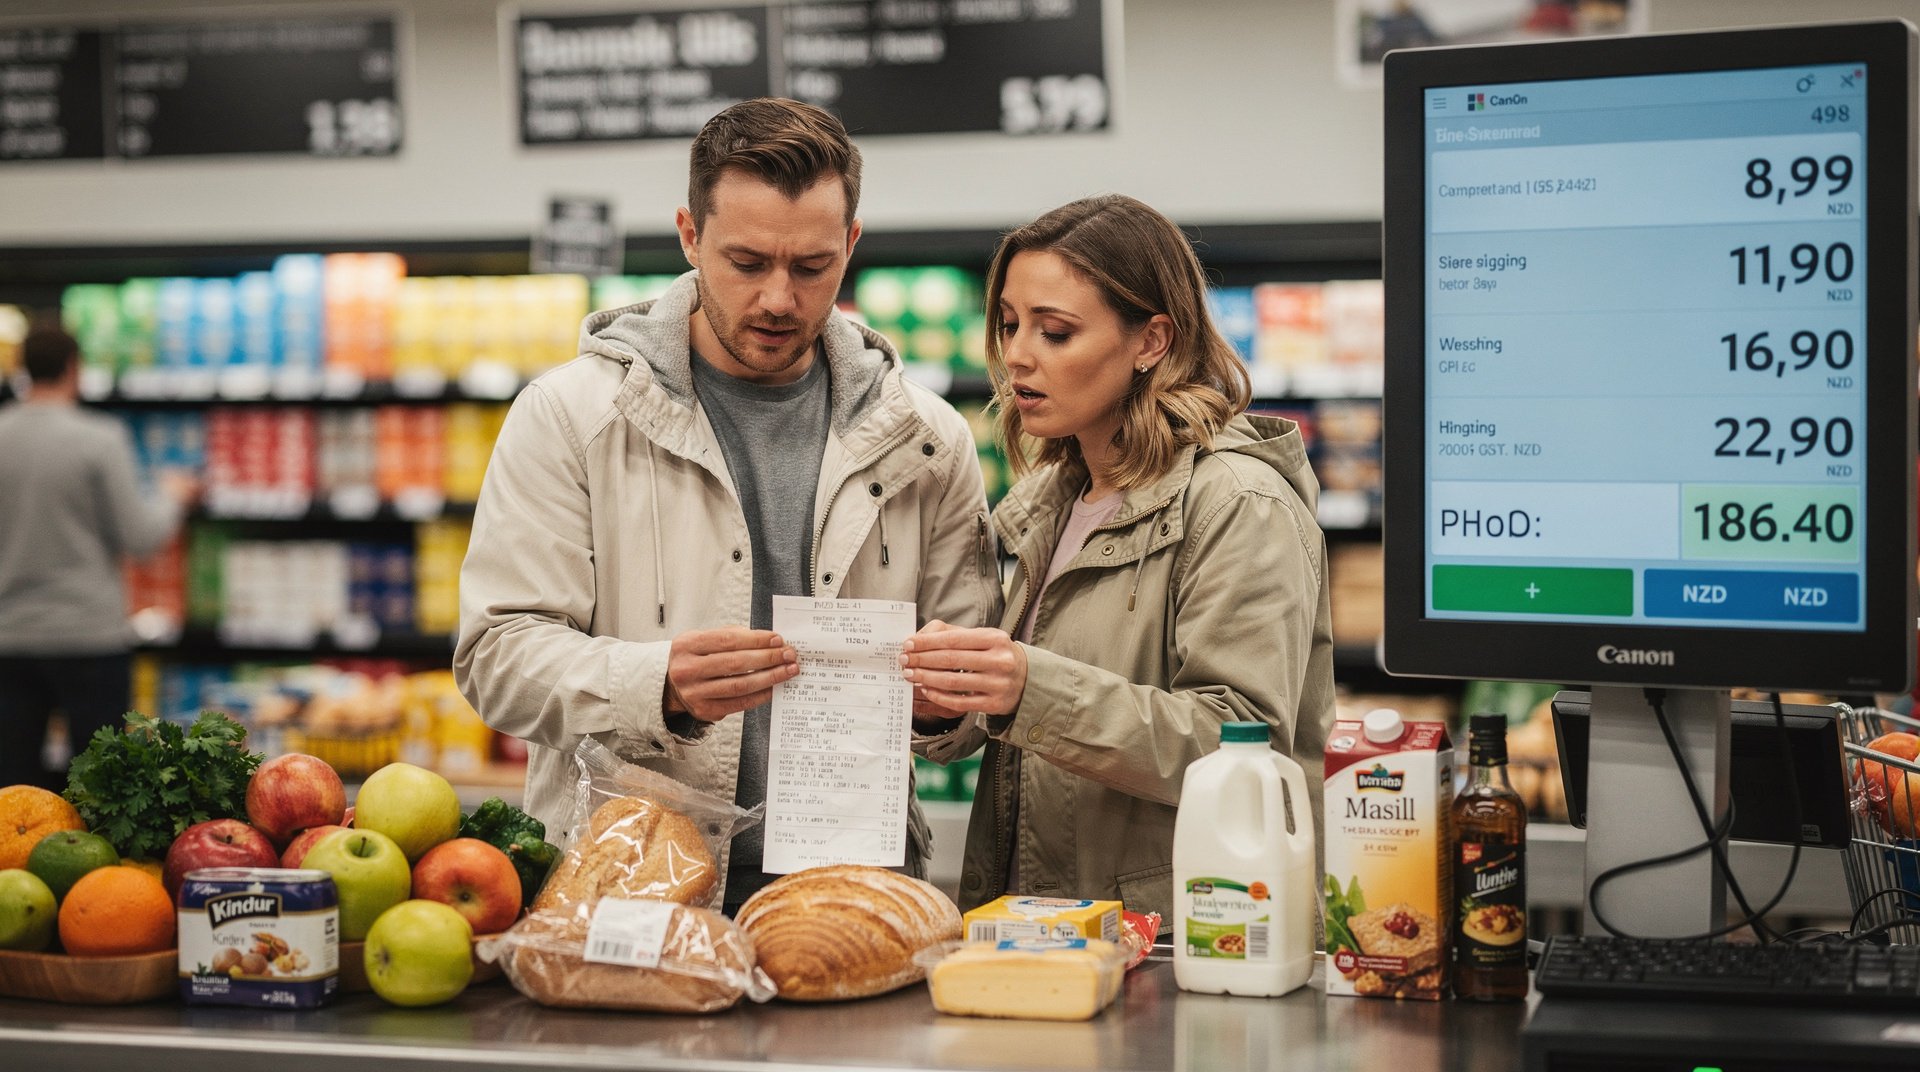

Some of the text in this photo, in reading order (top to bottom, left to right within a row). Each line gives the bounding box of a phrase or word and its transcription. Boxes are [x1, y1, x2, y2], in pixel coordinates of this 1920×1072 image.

[1811, 104, 1850, 123] 498
[1745, 155, 1853, 205] 8,99
[1827, 203, 1854, 215] NZD
[1476, 253, 1527, 271] sigging
[1730, 241, 1854, 293] 11,90
[1827, 289, 1853, 301] NZD
[1721, 330, 1854, 378] 16,90
[1827, 377, 1853, 389] NZD
[1439, 419, 1496, 437] Hingting
[1514, 443, 1542, 456] NZD
[1714, 416, 1854, 465] 22,90
[1826, 465, 1853, 477] NZD
[1441, 509, 1541, 538] PHoD:
[1694, 502, 1854, 543] 186.40
[1683, 584, 1828, 606] NZD NZD
[1597, 644, 1675, 667] Canon
[1345, 797, 1416, 821] Masill
[211, 896, 276, 923] Kindur
